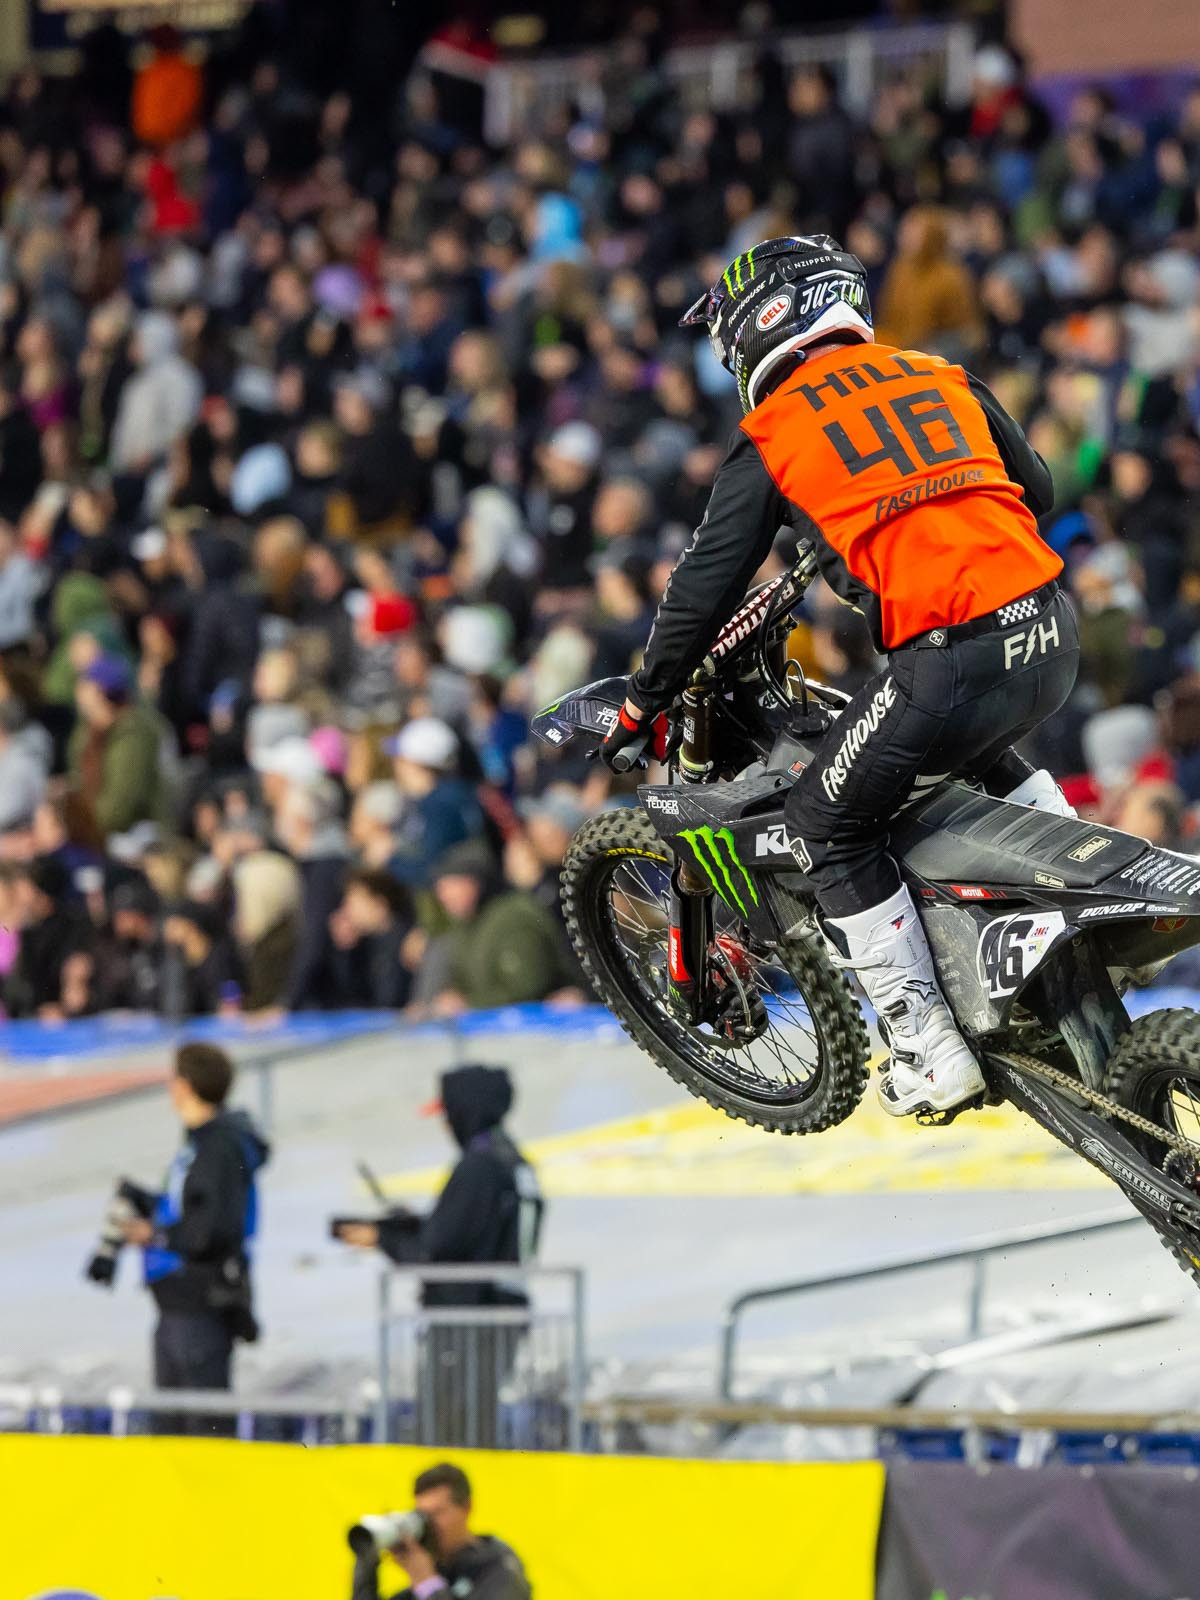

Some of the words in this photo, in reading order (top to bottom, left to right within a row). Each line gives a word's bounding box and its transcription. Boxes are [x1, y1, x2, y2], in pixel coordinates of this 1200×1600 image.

[800, 279, 864, 314] JUSTIN
[760, 301, 787, 326] BELL
[822, 389, 973, 477] 46
[875, 469, 985, 522] FASTHOUSE
[545, 727, 562, 743] KTM
[821, 676, 897, 802] FASTHOUSE
[646, 799, 679, 809] TEDDER
[961, 888, 985, 897] MOTUL
[1078, 902, 1146, 919] DUNLOP
[981, 919, 1035, 992] 46
